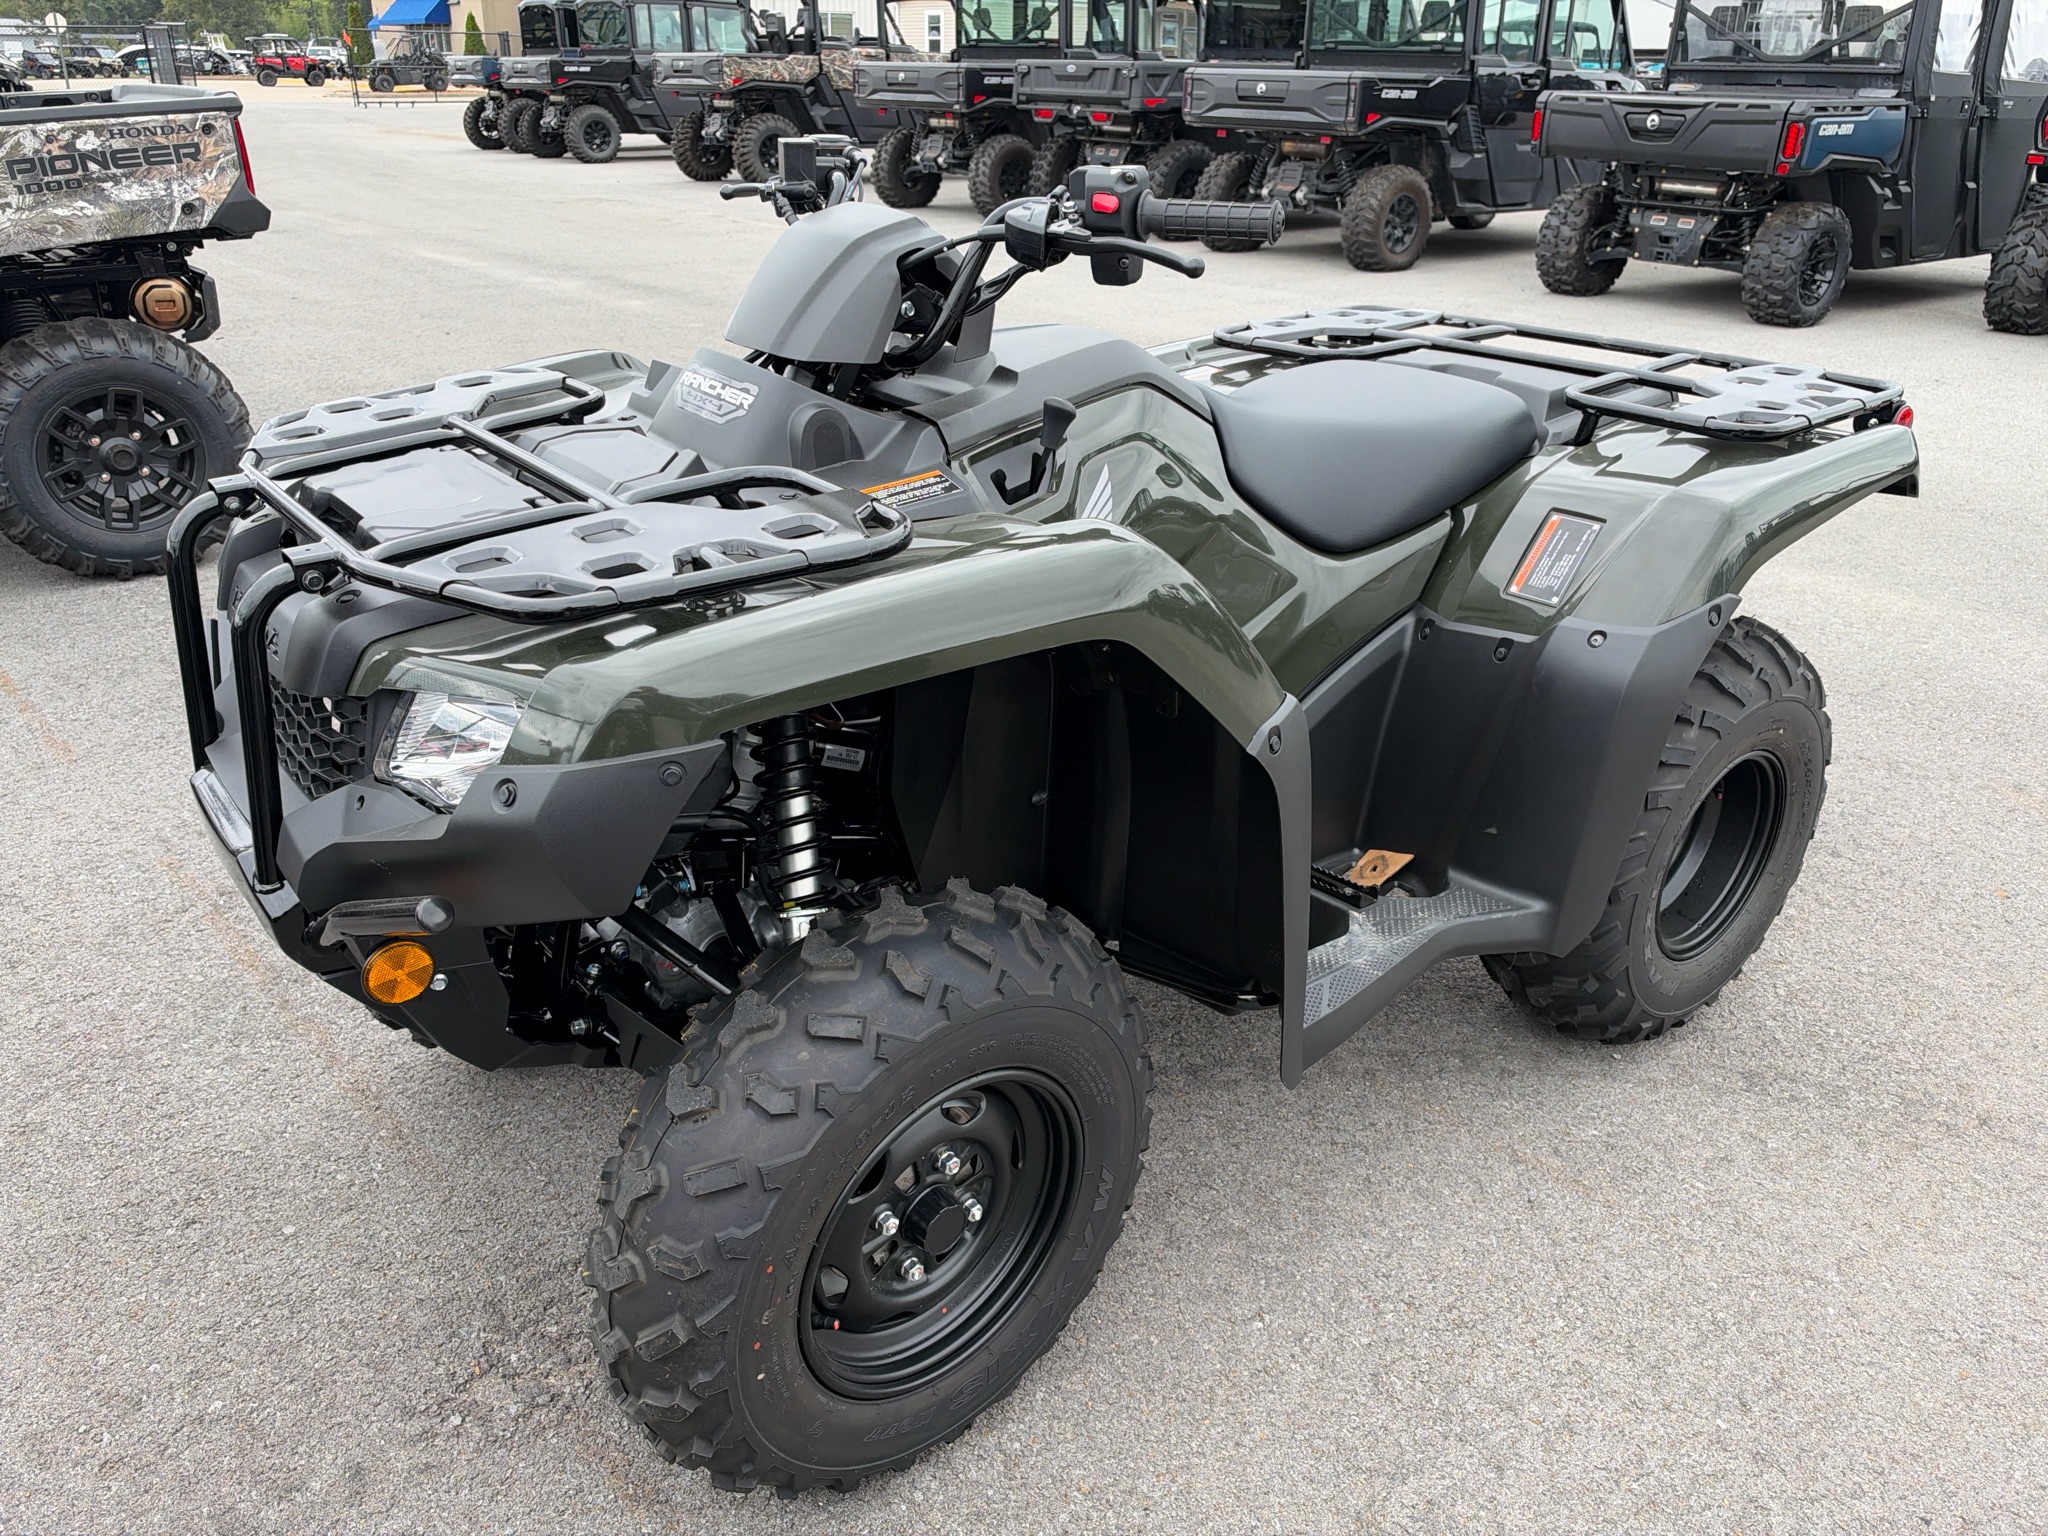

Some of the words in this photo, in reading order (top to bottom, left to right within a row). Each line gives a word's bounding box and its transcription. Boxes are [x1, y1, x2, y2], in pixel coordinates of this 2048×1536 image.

[106, 124, 192, 140] HONDA
[5, 142, 202, 181] PIONEER
[15, 178, 83, 196] 1000
[679, 370, 756, 410] RANCHER
[1527, 531, 1551, 570] WARNING
[949, 1162, 1116, 1411] MAXXIS
